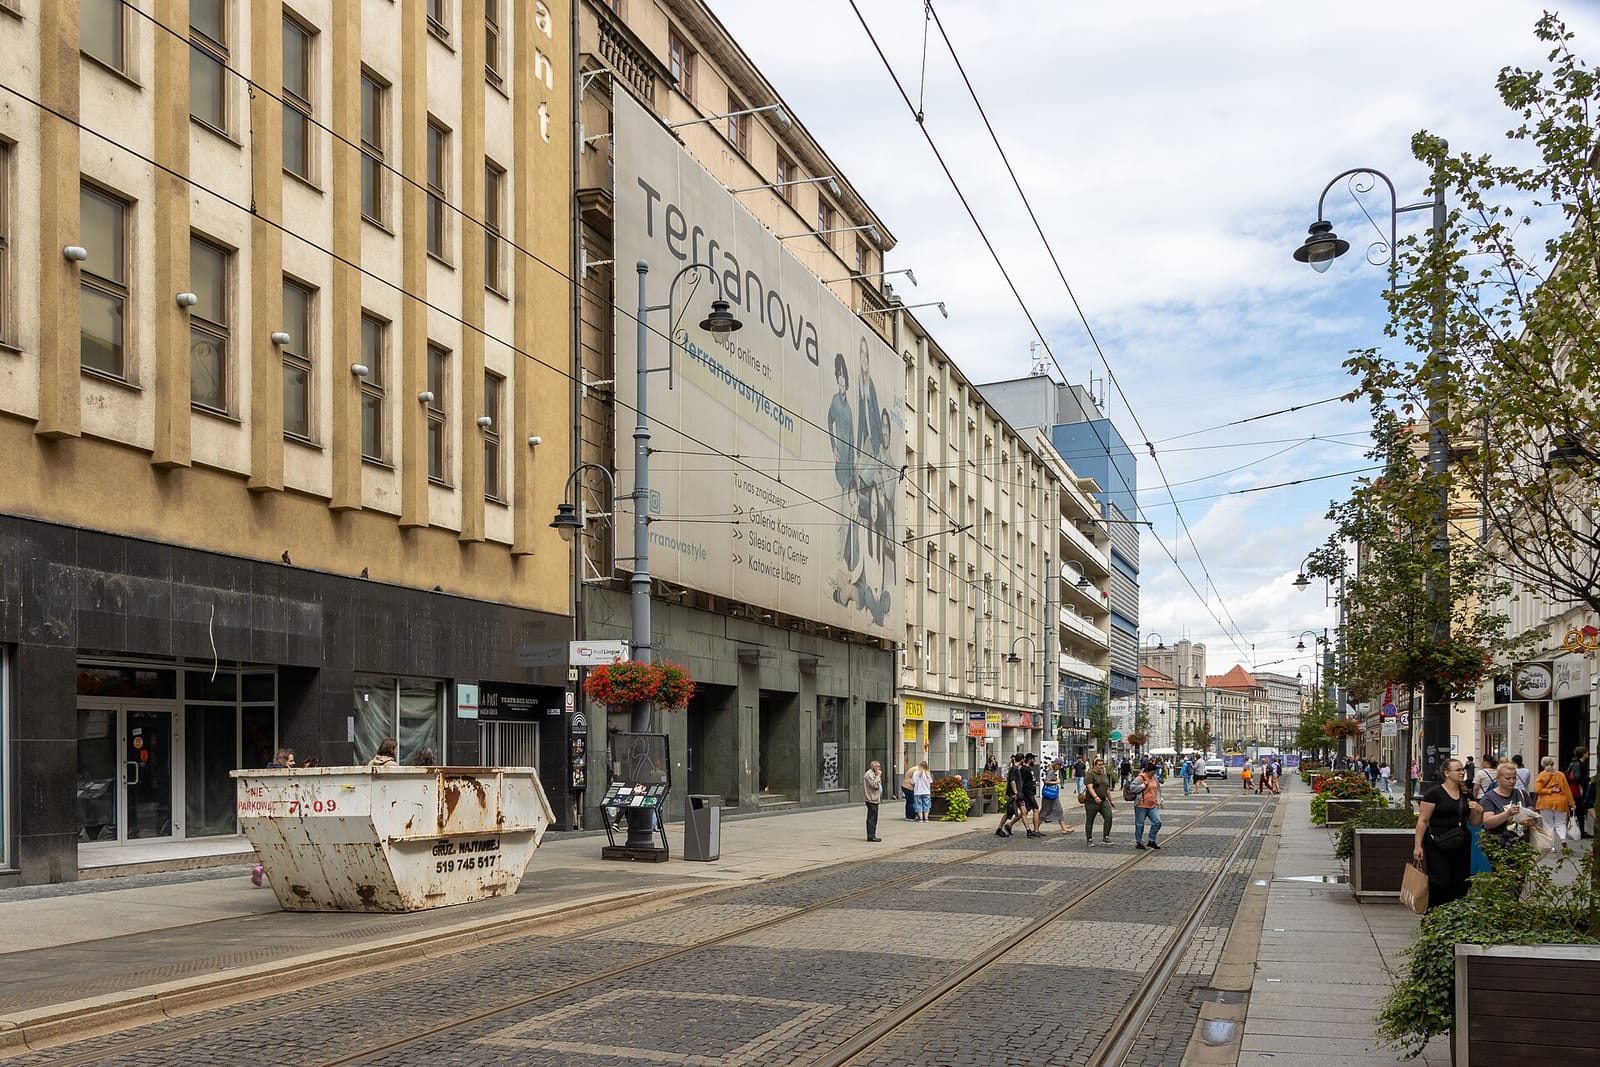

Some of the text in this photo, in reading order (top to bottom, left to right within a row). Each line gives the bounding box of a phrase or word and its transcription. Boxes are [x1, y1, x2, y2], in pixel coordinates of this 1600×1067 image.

[637, 176, 819, 367] Terranova
[737, 347, 761, 374] online
[762, 364, 772, 380] at:
[684, 332, 794, 432] terranovastyle.com
[733, 472, 742, 488] Tu
[743, 481, 754, 496] nas
[749, 507, 810, 545] Galeria Katowicka
[749, 530, 809, 567] Silesia City Center
[748, 554, 801, 586] Katowice Libero
[250, 787, 263, 797] NIE
[436, 855, 496, 873] 519 745 517
